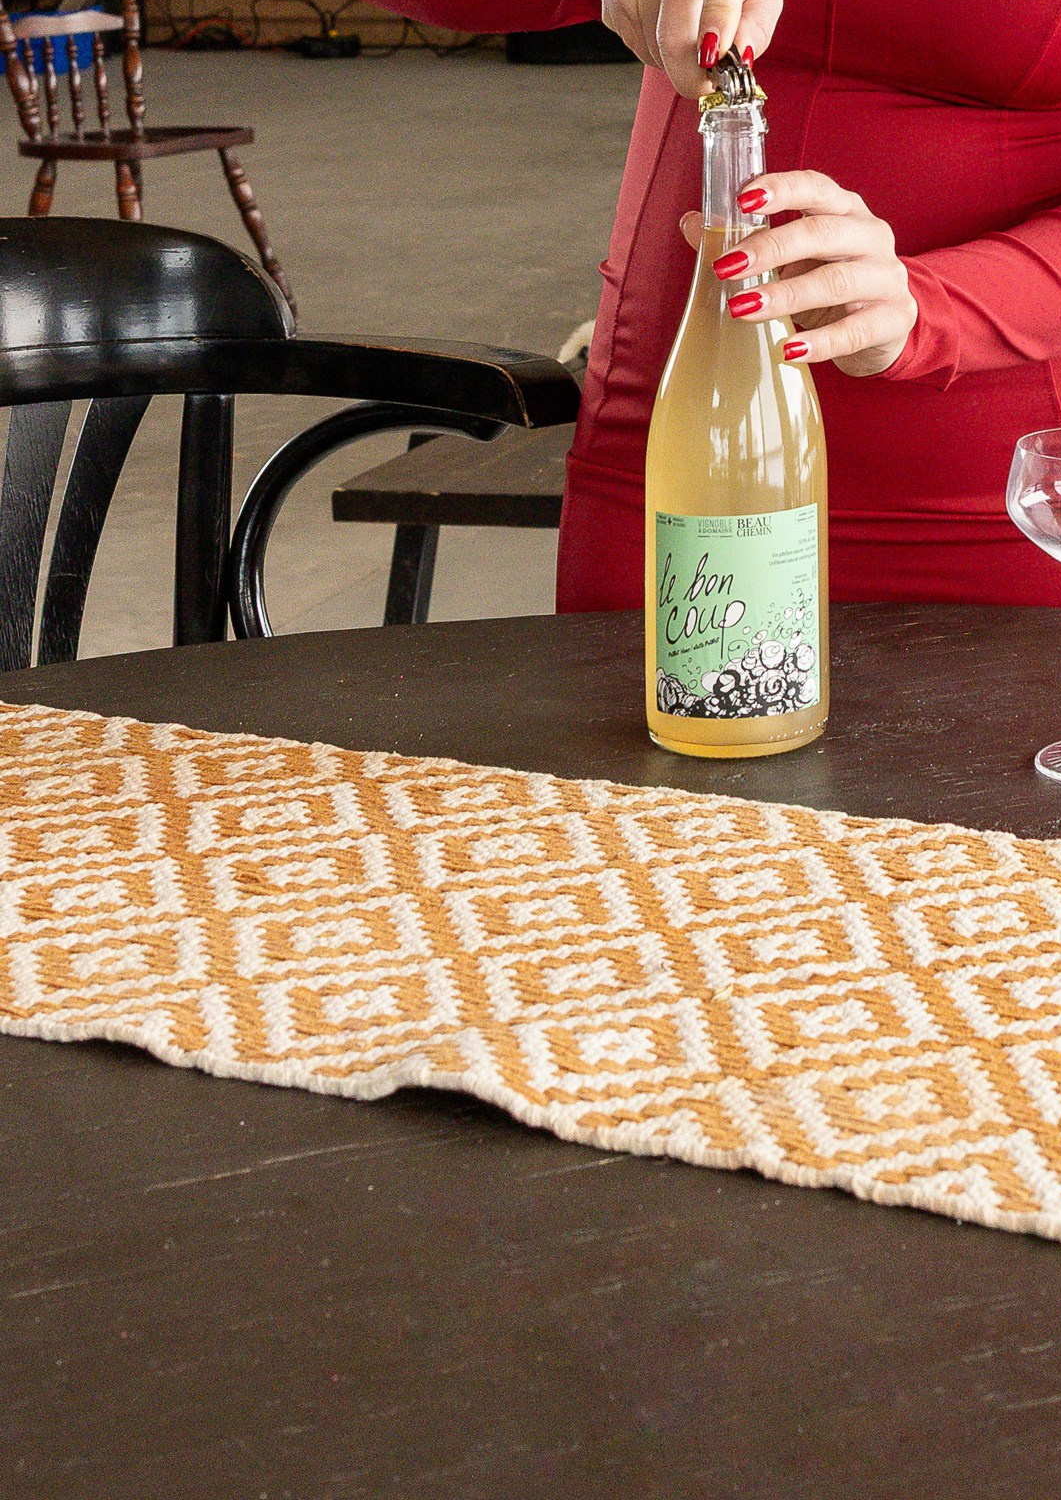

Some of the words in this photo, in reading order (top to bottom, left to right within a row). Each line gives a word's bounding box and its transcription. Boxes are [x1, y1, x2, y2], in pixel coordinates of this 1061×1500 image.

[697, 518, 733, 528] VIGNOBLE
[737, 516, 772, 529] BEAU
[736, 526, 772, 537] CHEMIN
[659, 552, 676, 608] le
[683, 552, 734, 602] bon
[665, 599, 747, 660] coup
